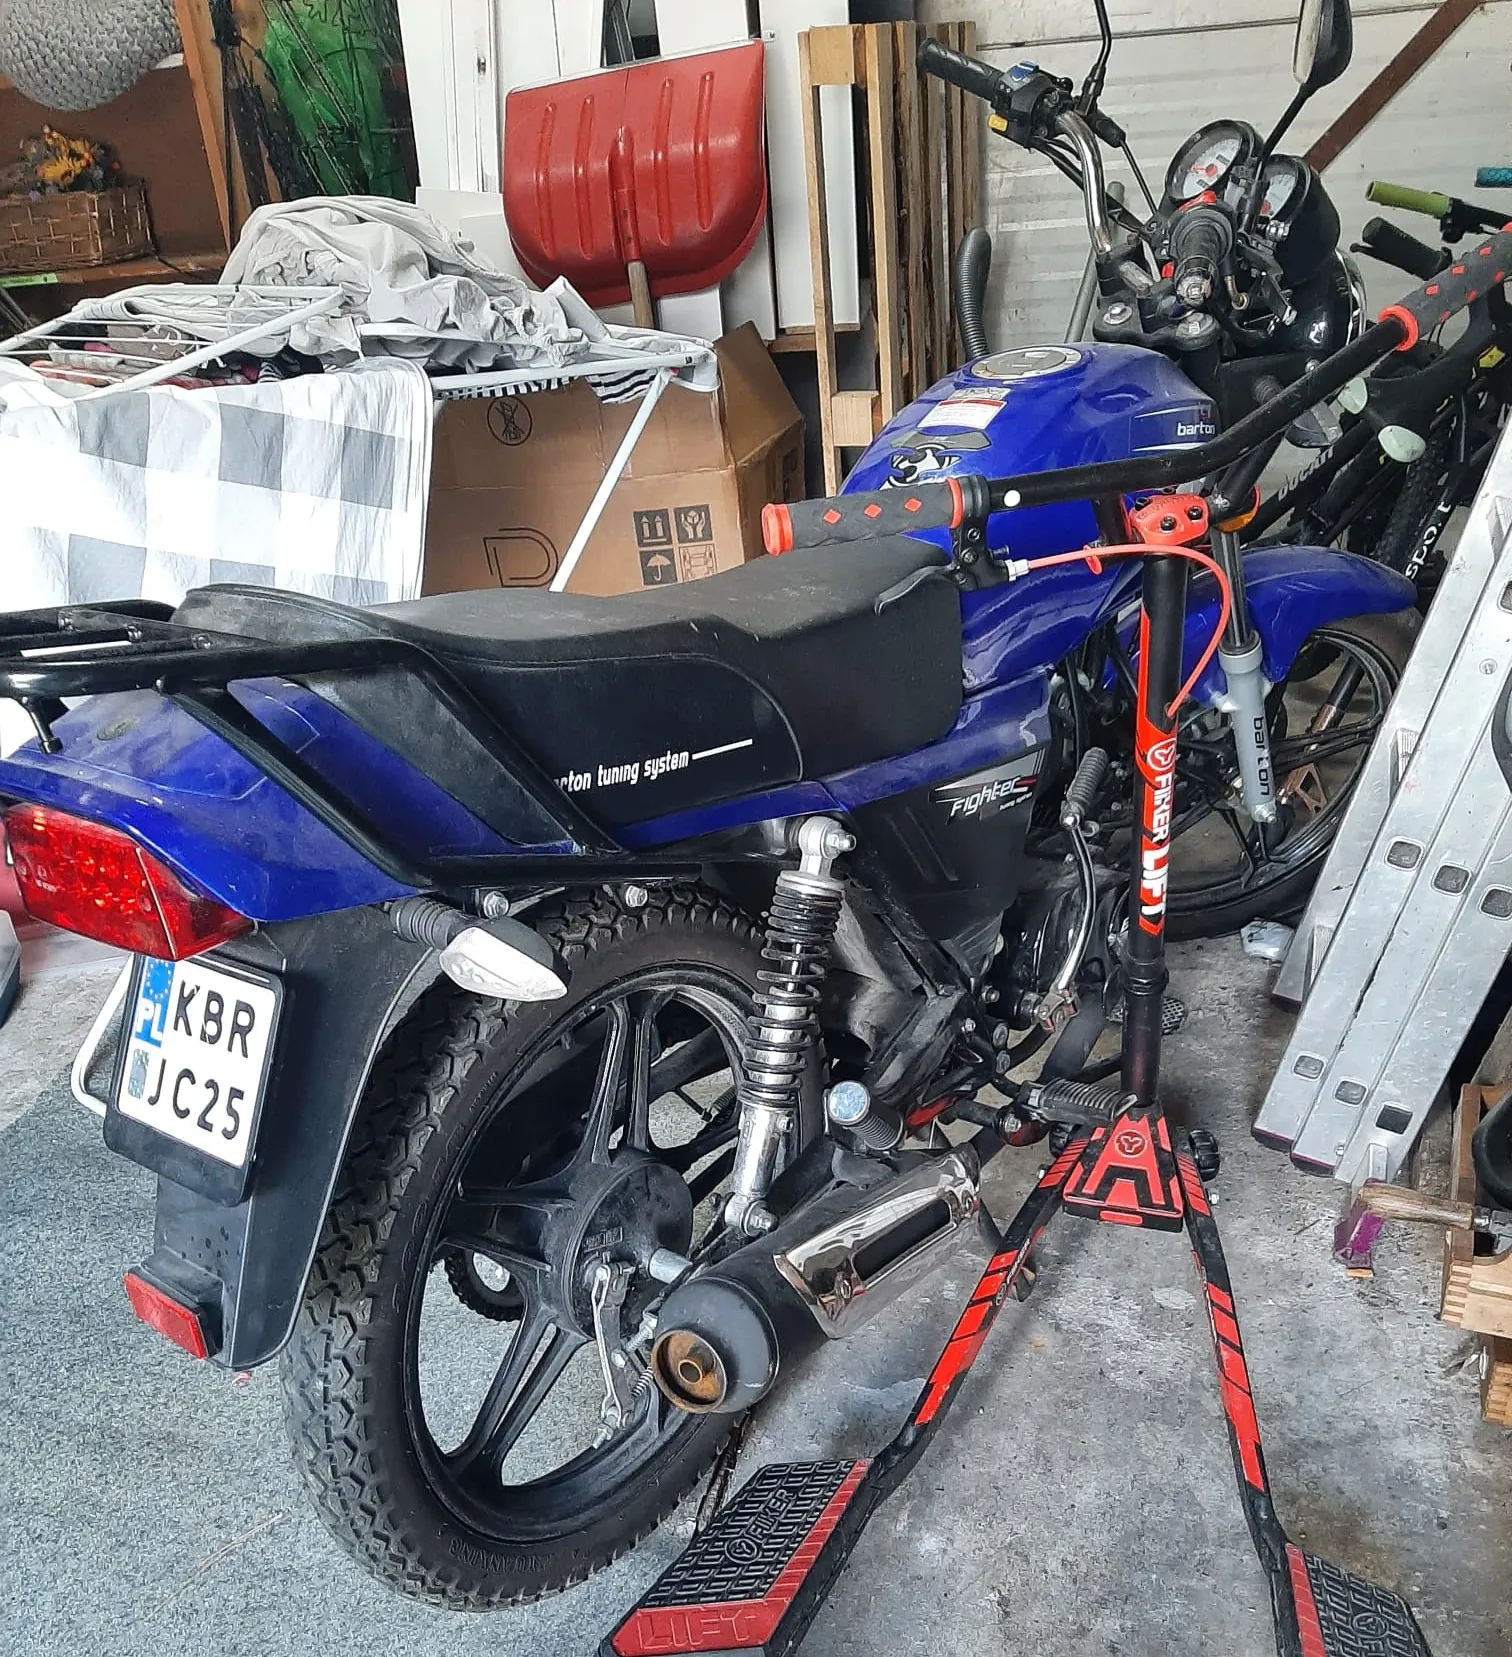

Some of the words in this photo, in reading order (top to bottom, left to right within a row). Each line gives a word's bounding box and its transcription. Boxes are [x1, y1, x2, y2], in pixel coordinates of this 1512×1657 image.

[1177, 421, 1216, 436] barton
[1405, 501, 1451, 580] spot
[597, 764, 640, 785] tuning
[643, 750, 690, 781] system
[1253, 716, 1271, 796] barton
[1141, 843, 1169, 916] LIFT
[135, 997, 164, 1043] PL
[173, 980, 256, 1058] KBR
[147, 1057, 245, 1140] JC25
[636, 1607, 757, 1650] LIFT
